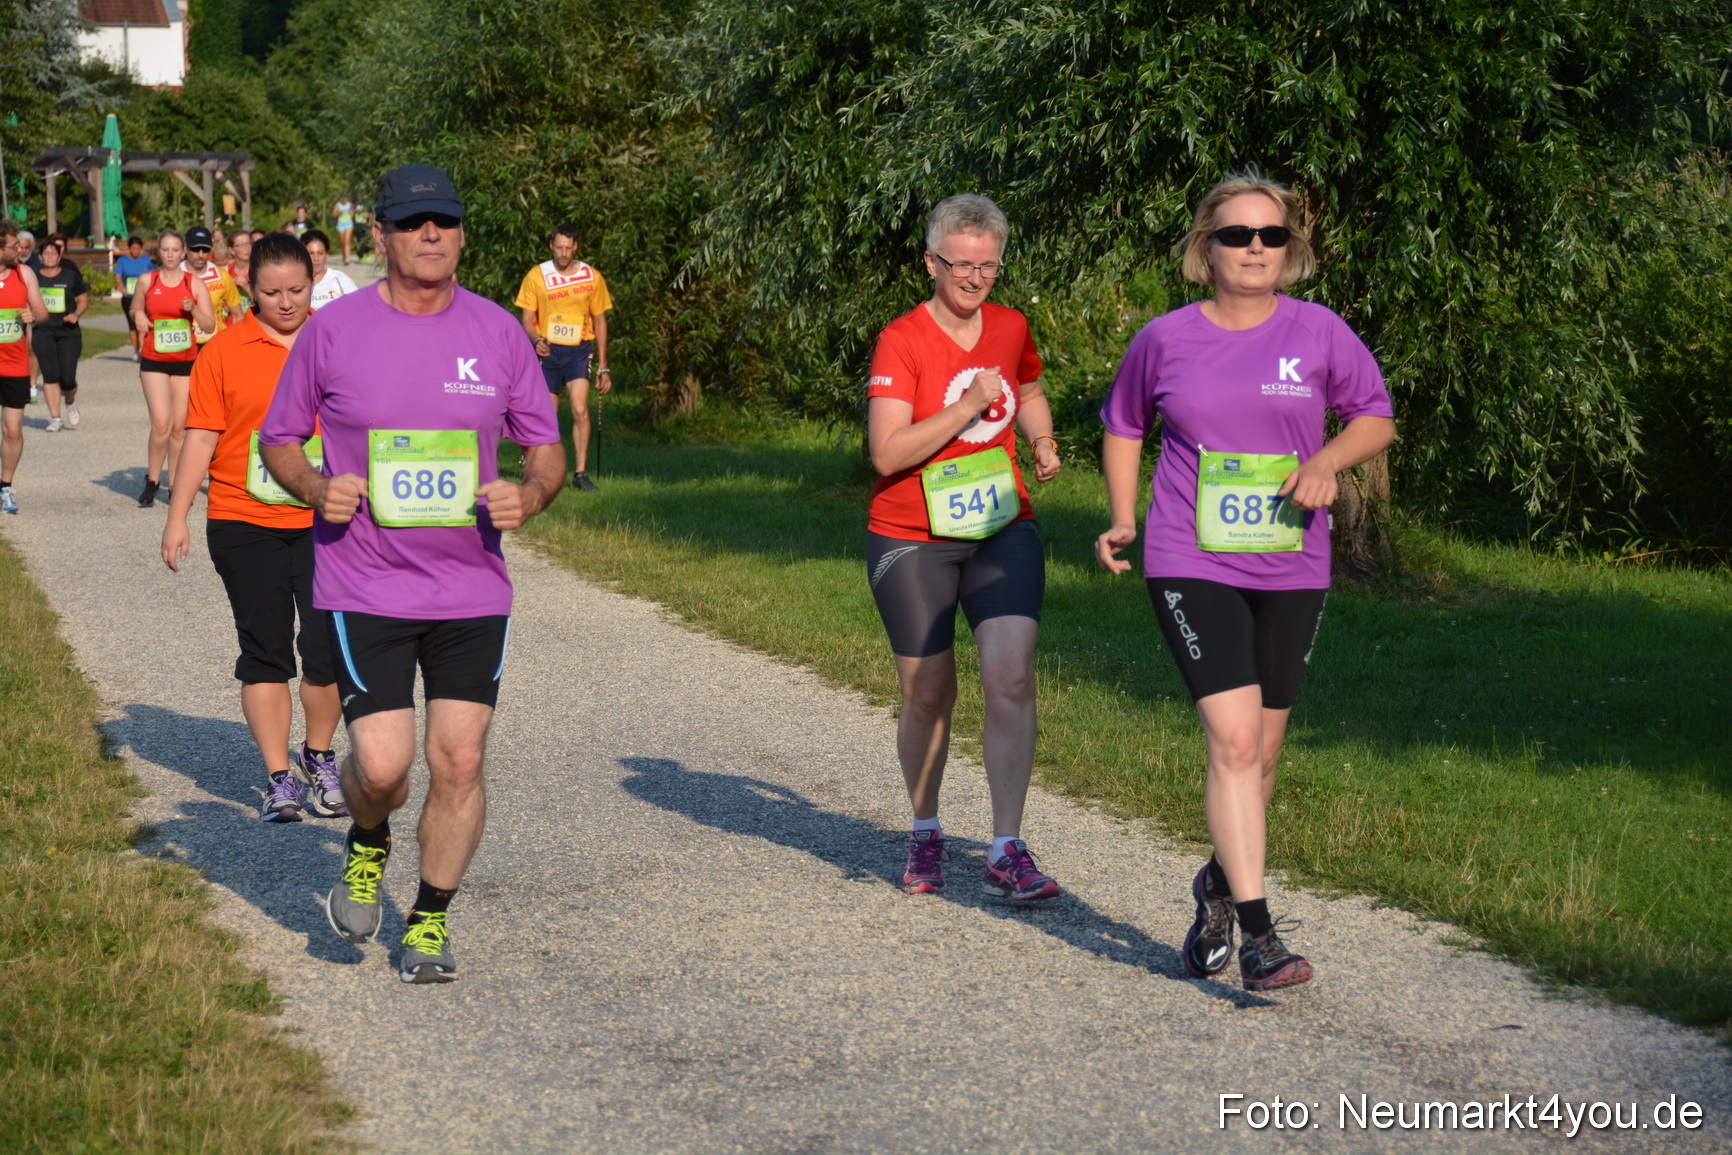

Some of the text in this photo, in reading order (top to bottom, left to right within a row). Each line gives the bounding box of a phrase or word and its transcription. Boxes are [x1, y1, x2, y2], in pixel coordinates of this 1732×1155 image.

[208, 283, 225, 292] ÖGL
[311, 290, 335, 301] lus1
[548, 289, 570, 301] MAX
[553, 324, 575, 337] 901
[158, 331, 188, 344] 1363
[457, 357, 481, 382] K
[1279, 357, 1303, 383] K
[443, 382, 496, 393] KÜFNER
[1261, 382, 1312, 393] KÜFNER
[386, 446, 425, 455] firmenlauf
[938, 470, 970, 482] firmenlauf
[1216, 470, 1255, 479] firmenlauf
[392, 469, 457, 500] 686
[949, 484, 1000, 520] 541
[1219, 493, 1285, 525] 687
[949, 524, 968, 533] Ursula
[1228, 531, 1275, 539] Sandra Küfner
[1173, 608, 1202, 660] odlo
